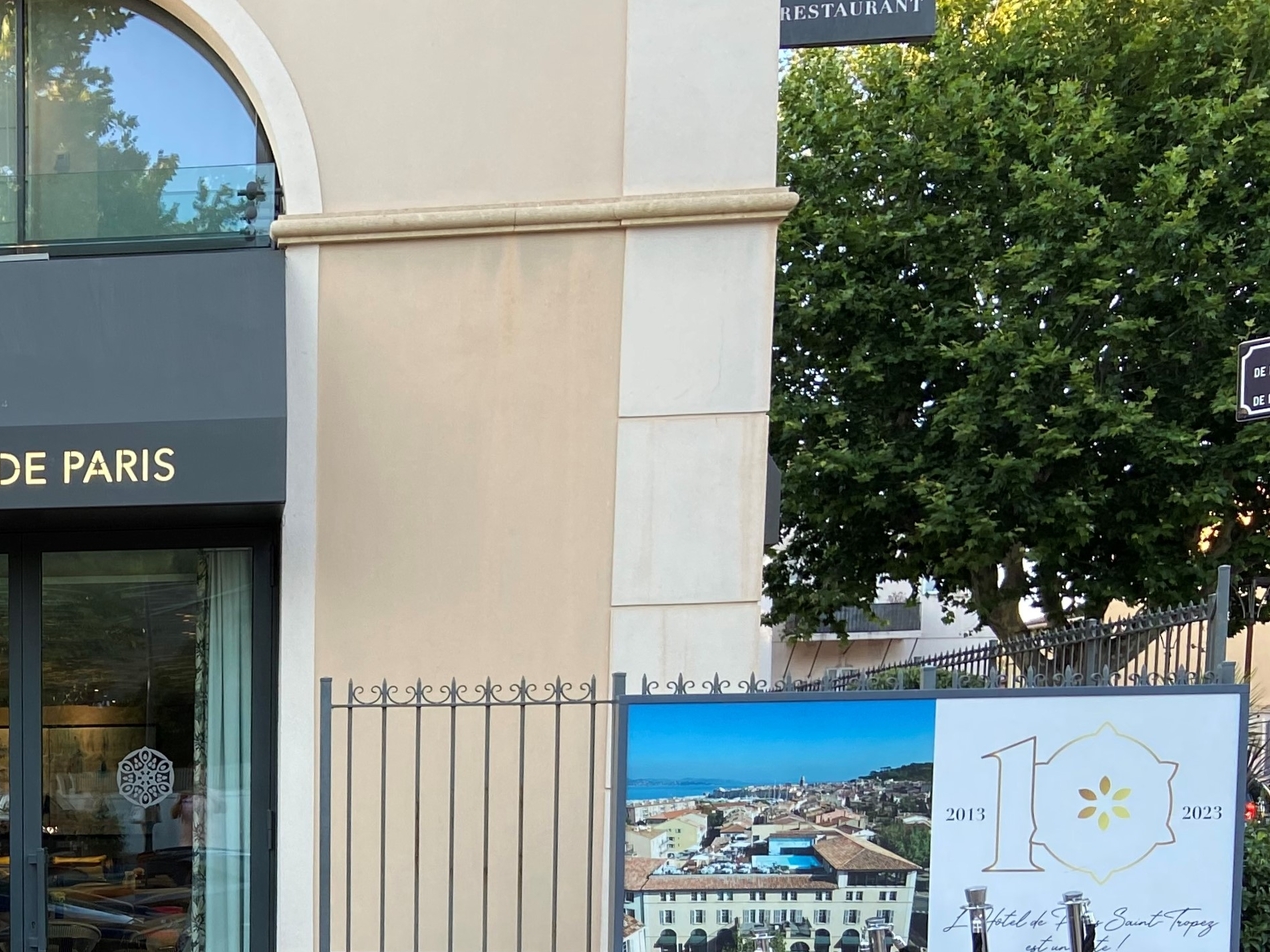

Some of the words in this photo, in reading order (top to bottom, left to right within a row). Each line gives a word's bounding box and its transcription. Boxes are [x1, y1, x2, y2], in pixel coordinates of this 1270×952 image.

[780, 0, 924, 21] RESTAURANT
[1253, 366, 1267, 378] DE
[1252, 394, 1266, 407] DE
[63, 447, 176, 484] PARIS
[945, 807, 986, 822] 2013
[1181, 805, 1223, 820] 2023
[1029, 910, 1048, 930] de
